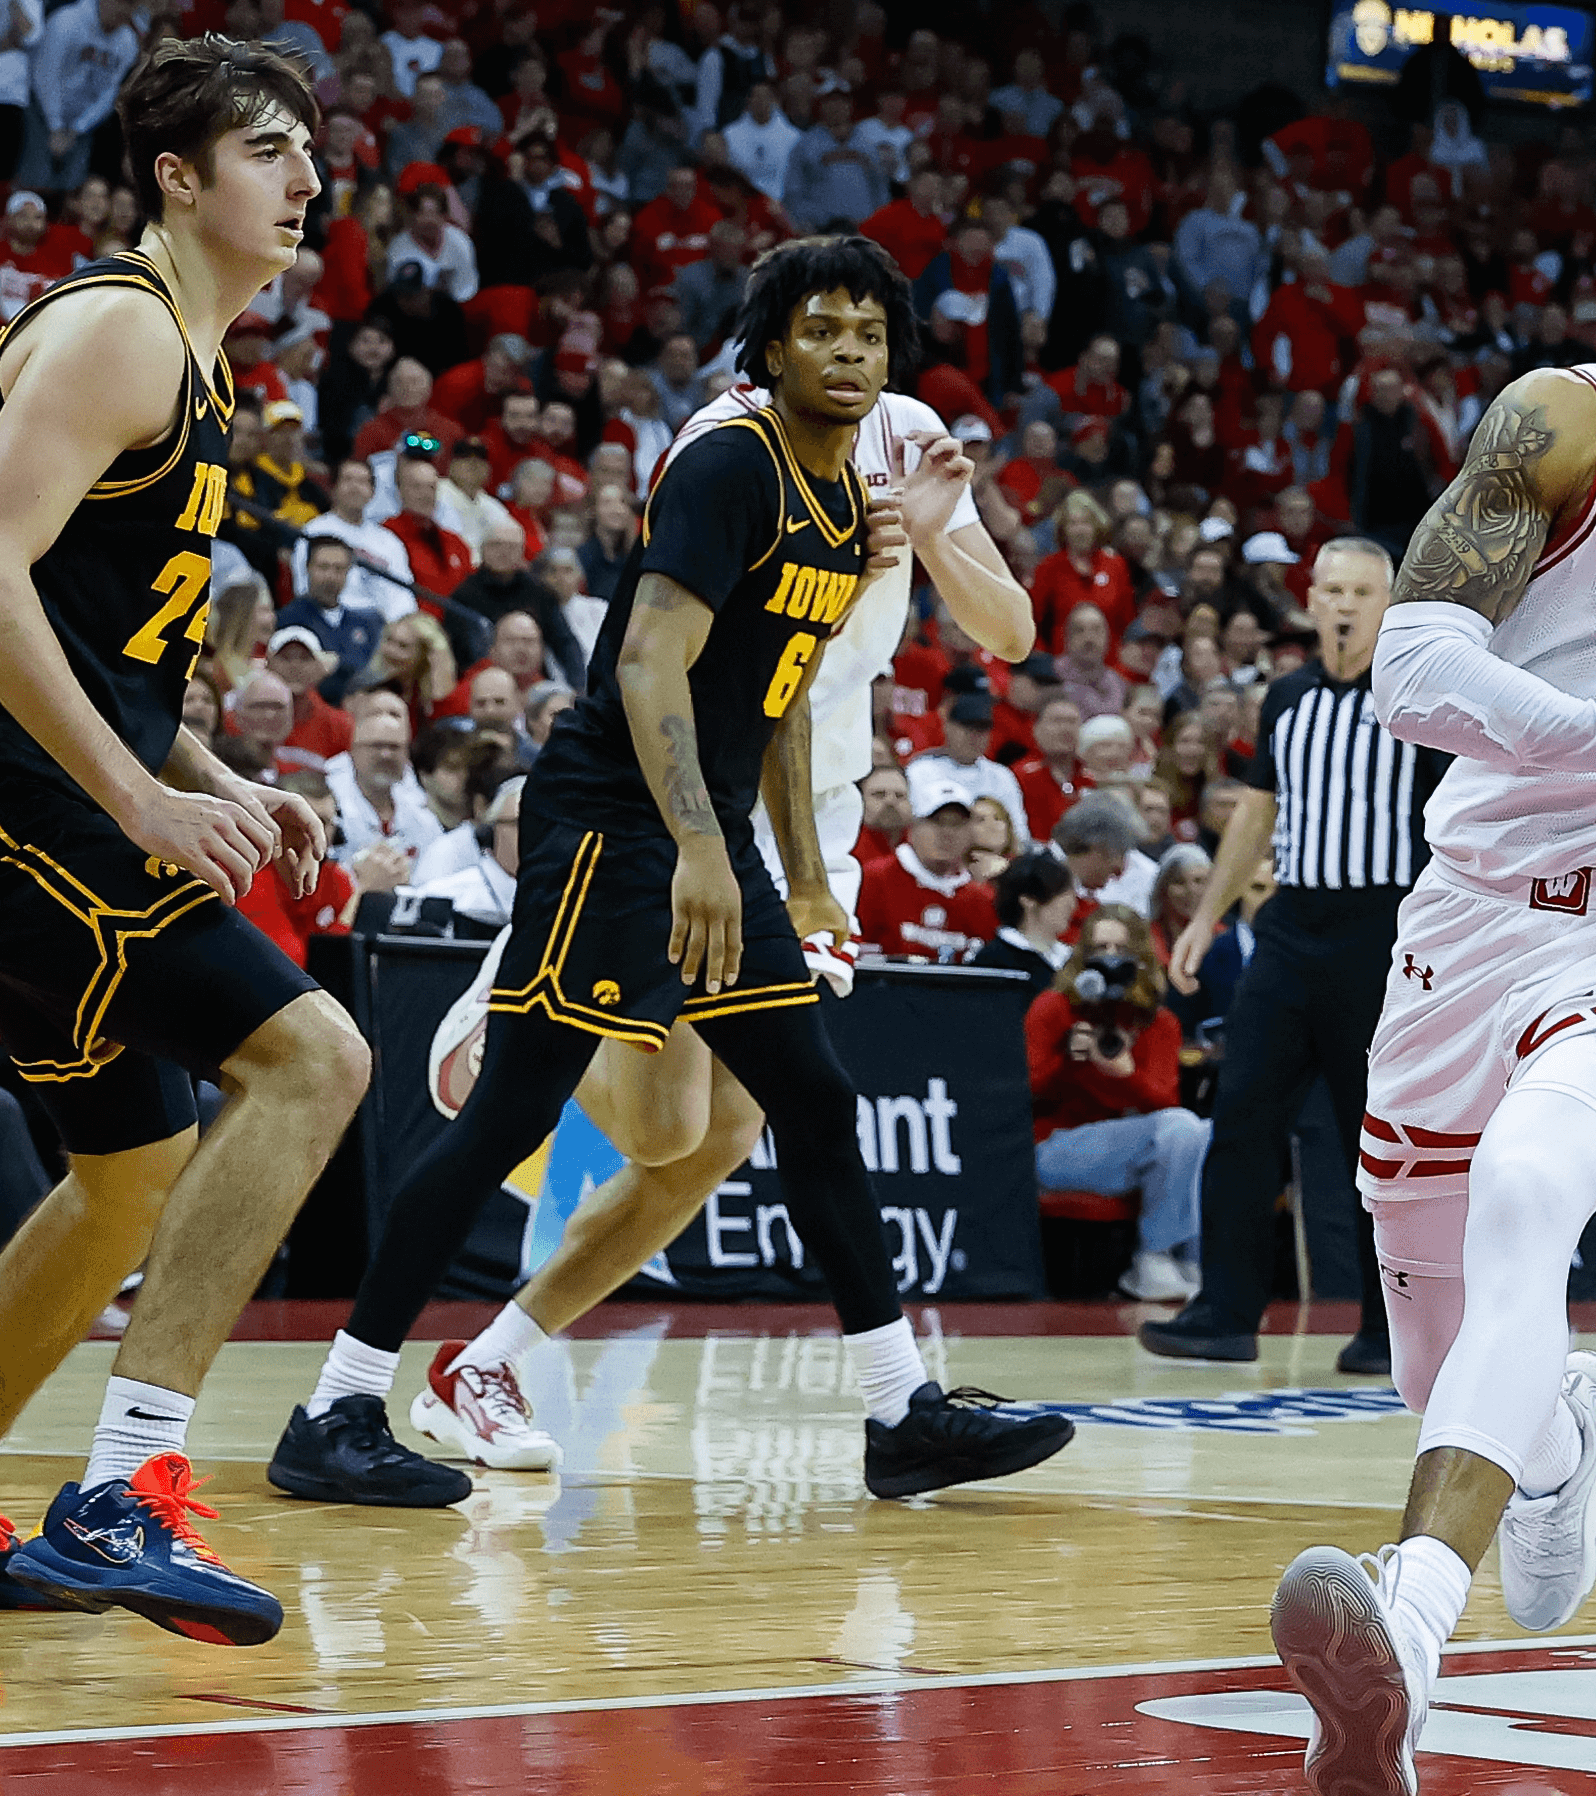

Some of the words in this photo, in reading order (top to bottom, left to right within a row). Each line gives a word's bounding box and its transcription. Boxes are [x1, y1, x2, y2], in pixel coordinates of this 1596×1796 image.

[174, 461, 228, 538] IO
[764, 561, 858, 624] IOW
[762, 631, 818, 719] 6
